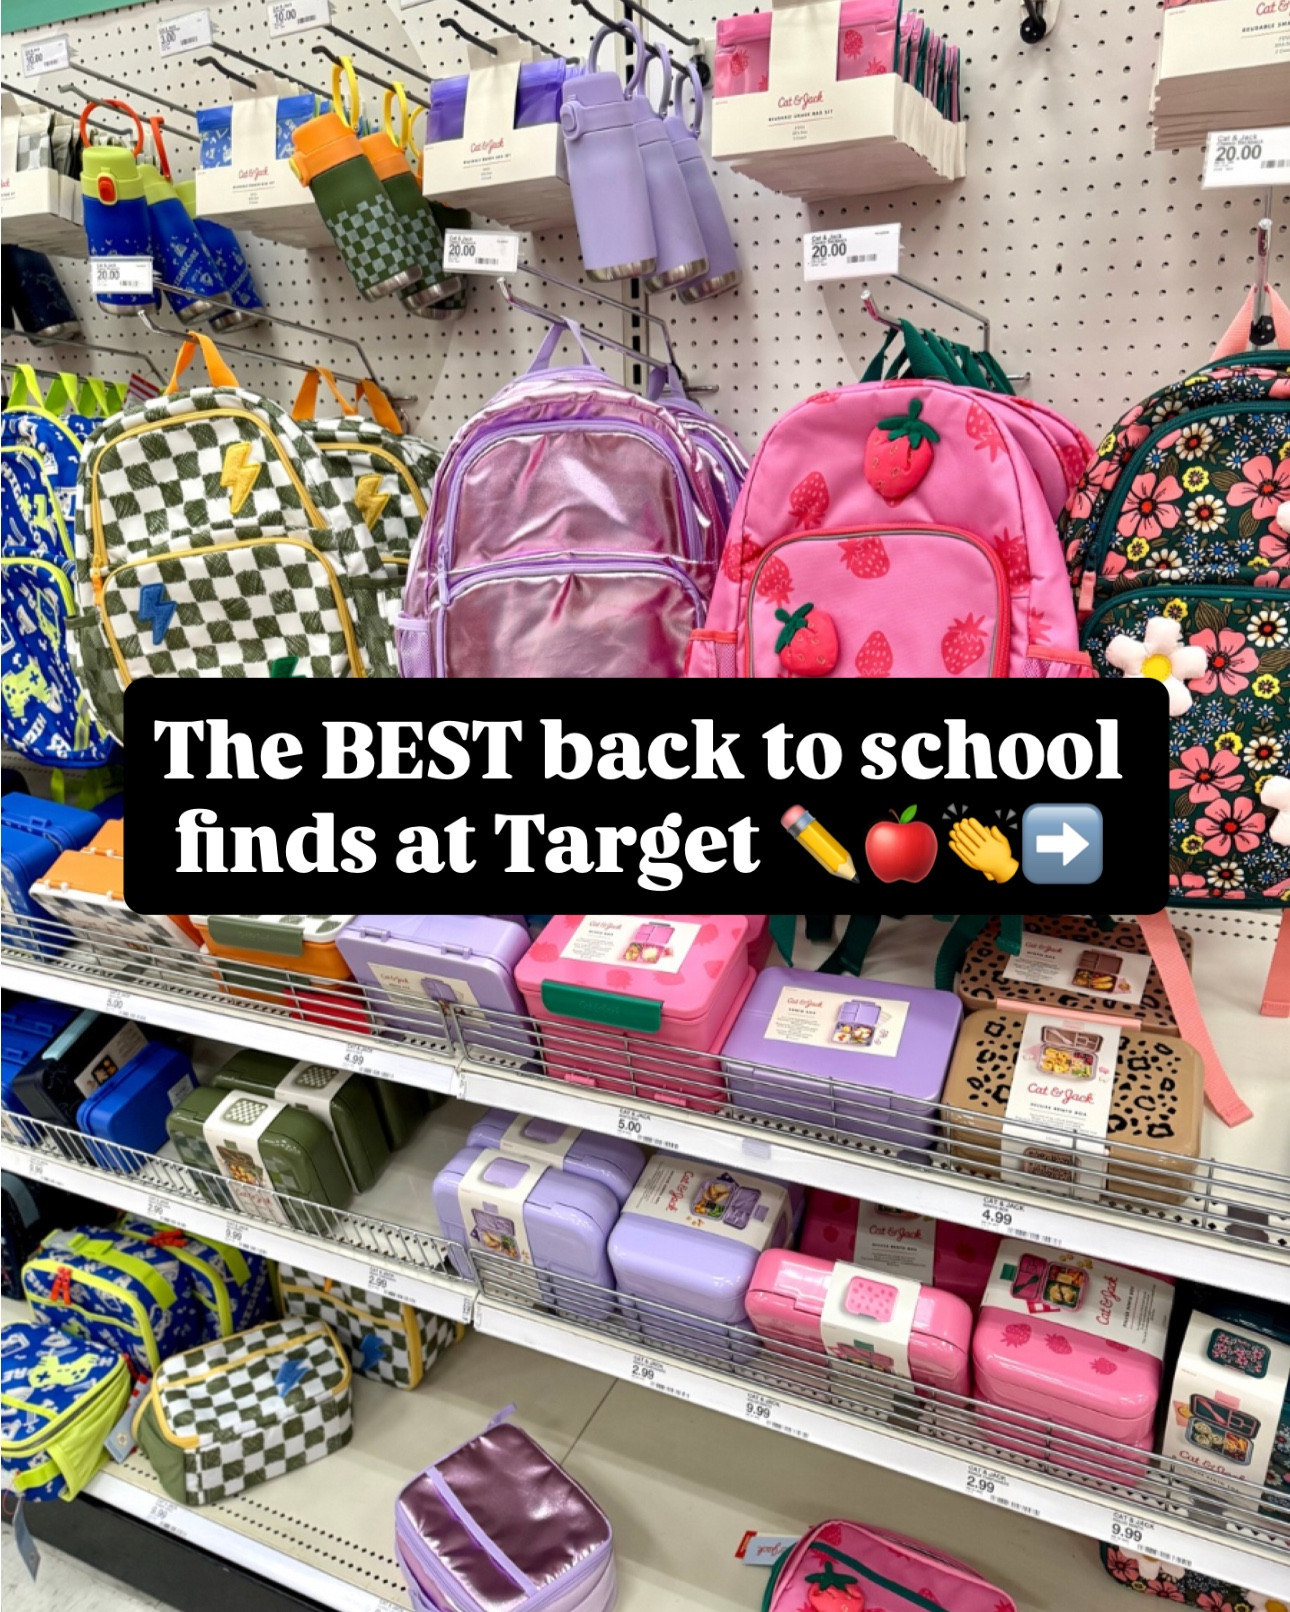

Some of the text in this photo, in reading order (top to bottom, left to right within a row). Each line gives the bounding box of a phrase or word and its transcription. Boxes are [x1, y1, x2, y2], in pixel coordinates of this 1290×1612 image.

[274, 9, 297, 22] 10.00
[1256, 2, 1276, 16] Cat
[778, 96, 792, 108] Cat
[802, 90, 824, 110] Jack
[470, 142, 481, 153] Cat
[486, 137, 504, 154] Jack
[1215, 144, 1262, 162] 20.00
[238, 170, 249, 179] Cat
[254, 167, 269, 181] Jack
[449, 244, 476, 257] 20.00
[811, 242, 848, 258] 20.00
[97, 270, 120, 281] 20.00
[22, 712, 47, 746] HIG
[804, 1000, 823, 1009] Jack
[345, 1053, 364, 1066] 4.99
[1027, 1083, 1095, 1104] Cat & Jack
[618, 1119, 642, 1133] 5.00
[983, 1197, 998, 1205] CAT
[1006, 1202, 1024, 1212] JACK
[982, 1208, 1012, 1226] 4.99
[869, 1224, 886, 1236] Cat
[896, 1227, 923, 1242] Jack
[369, 1275, 387, 1289] 2.99
[1101, 1274, 1121, 1302] Jack
[1096, 1308, 1111, 1326] Cat
[632, 1364, 654, 1380] 2.99
[746, 1402, 770, 1419] 9.99
[1179, 1450, 1200, 1465] Cat
[967, 1475, 994, 1493] 2.99
[1113, 1512, 1127, 1520] CAT
[1136, 1520, 1154, 1530] JACK
[1112, 1523, 1142, 1541] 9.99
